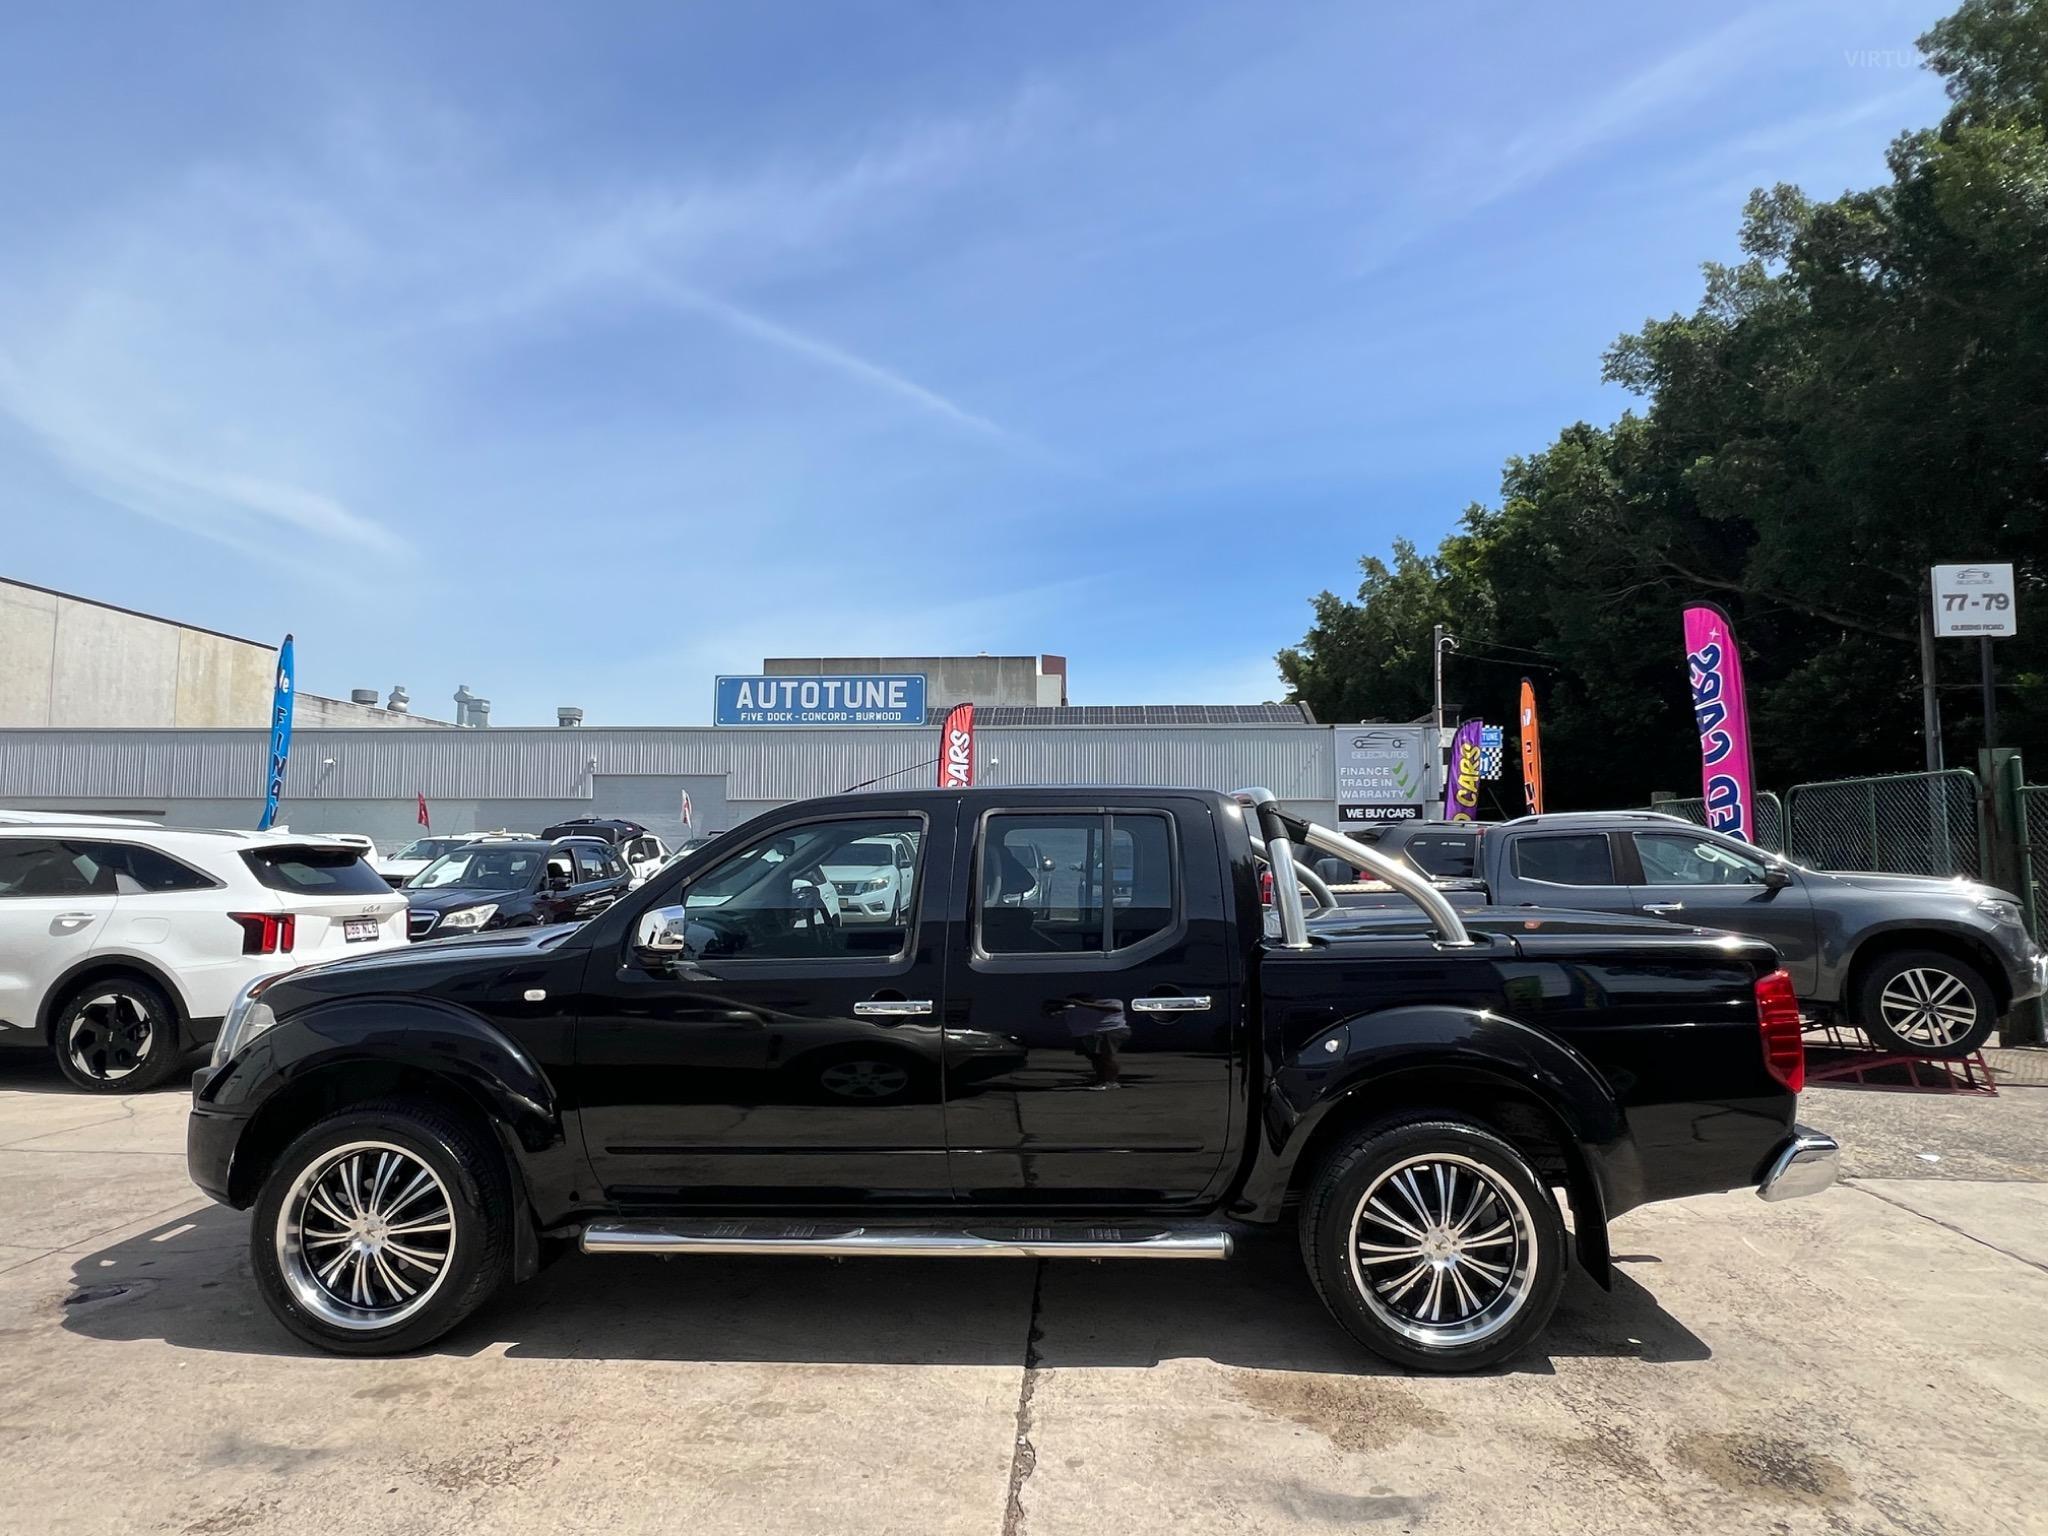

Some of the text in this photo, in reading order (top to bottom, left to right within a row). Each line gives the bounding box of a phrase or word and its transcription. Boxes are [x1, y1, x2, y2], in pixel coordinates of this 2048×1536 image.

[736, 681, 908, 709] AUTOTUNE
[741, 712, 763, 721] FIVE
[767, 712, 793, 721] DOCK
[801, 712, 847, 721] CONCORD
[856, 711, 901, 721] BURWOOD
[1340, 766, 1390, 776] FINANCE
[1456, 742, 1481, 808] CARS
[1340, 778, 1393, 787] TRADE IN
[1341, 790, 1405, 799] WARRANTY
[1346, 808, 1416, 819] WE BUY CARS
